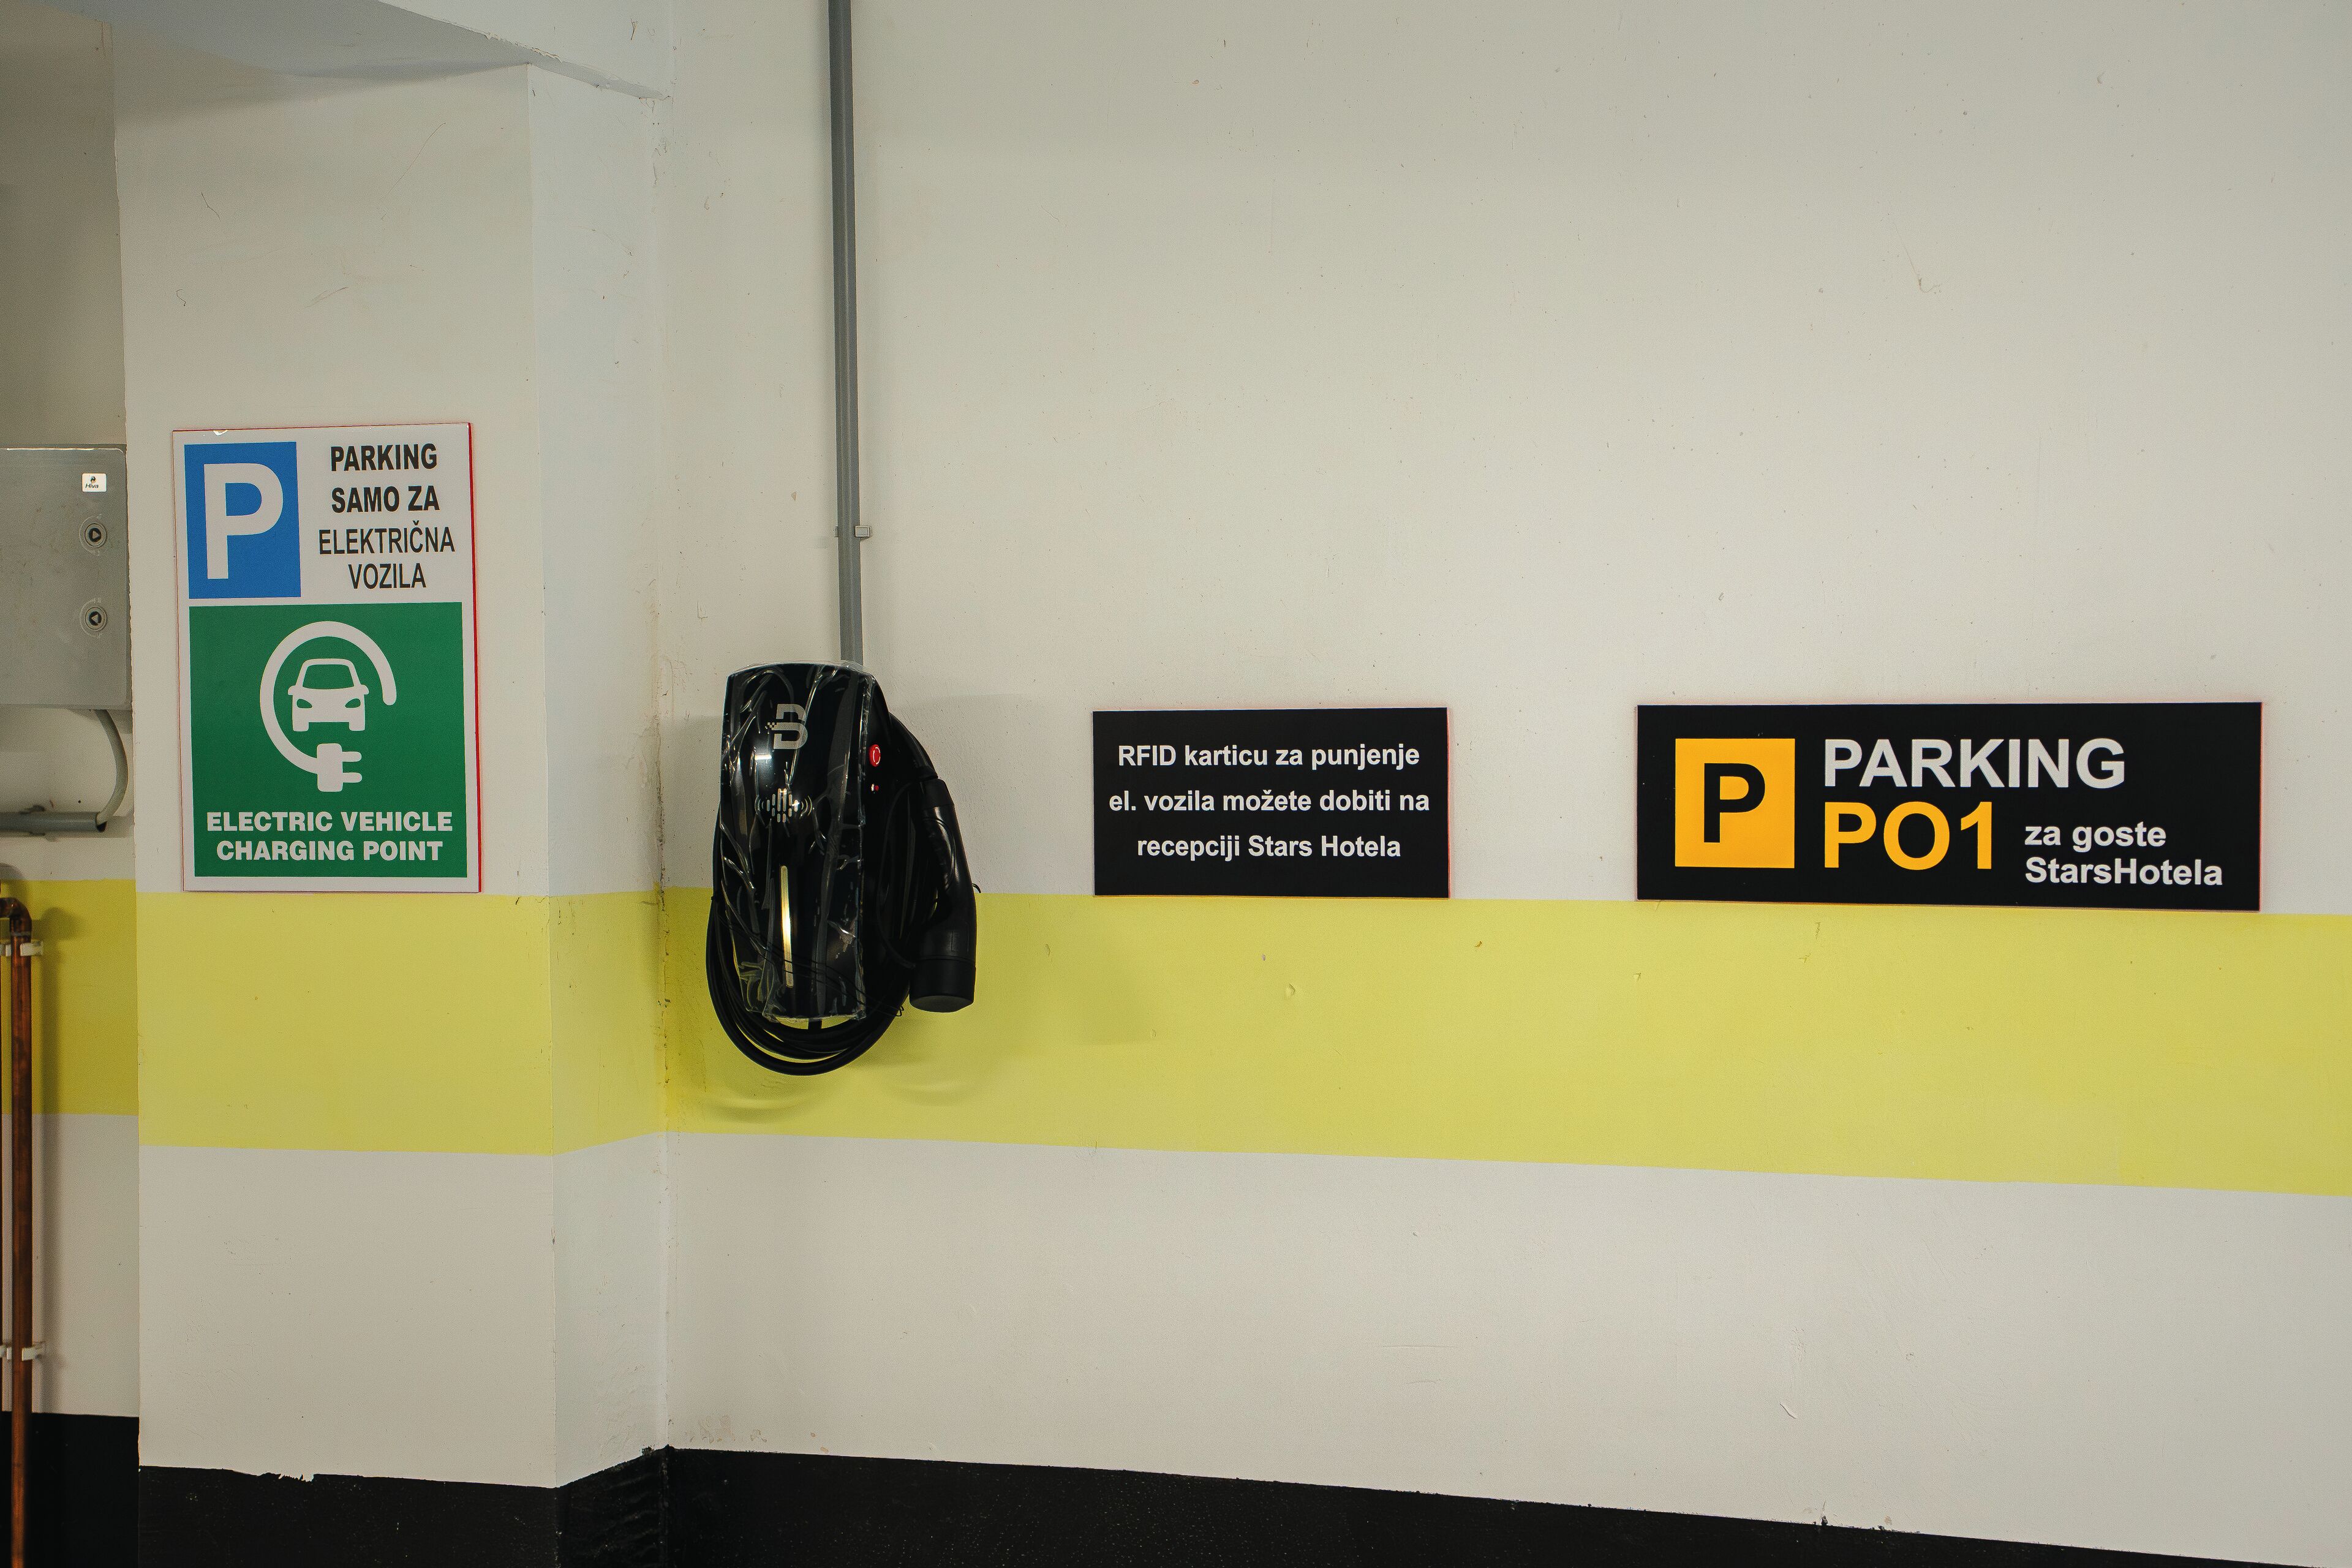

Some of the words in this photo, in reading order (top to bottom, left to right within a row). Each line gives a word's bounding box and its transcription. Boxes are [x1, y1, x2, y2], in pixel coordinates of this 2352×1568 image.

[331, 443, 437, 472] PARKING
[331, 486, 399, 513] SAMO
[409, 486, 440, 511] ZA
[203, 462, 284, 579] P
[319, 521, 455, 554] ELEKTRIČNA
[348, 563, 426, 589] VOZILA
[1119, 745, 1176, 766] RFID
[1185, 744, 1268, 766] karticu
[1275, 749, 1303, 766] za
[1312, 744, 1420, 770] punjenje
[1825, 738, 2124, 788] PARKING
[1109, 790, 1136, 812] el.
[1144, 790, 1215, 812] vozila
[1223, 789, 1311, 811] možete
[1319, 790, 1390, 811] dobiti
[1400, 794, 1430, 811] na
[1704, 763, 1766, 843] P
[206, 811, 333, 832] ELECTRIC
[341, 811, 453, 832] VEHICLE
[216, 840, 355, 861] CHARGING
[363, 840, 443, 861] POINT
[1137, 835, 1240, 862] recepciji
[1248, 835, 1313, 857] Stars
[1321, 835, 1401, 857] Hotela
[2024, 826, 2061, 846] za
[2072, 821, 2166, 853] goste
[2025, 856, 2223, 886] StarsHotela
